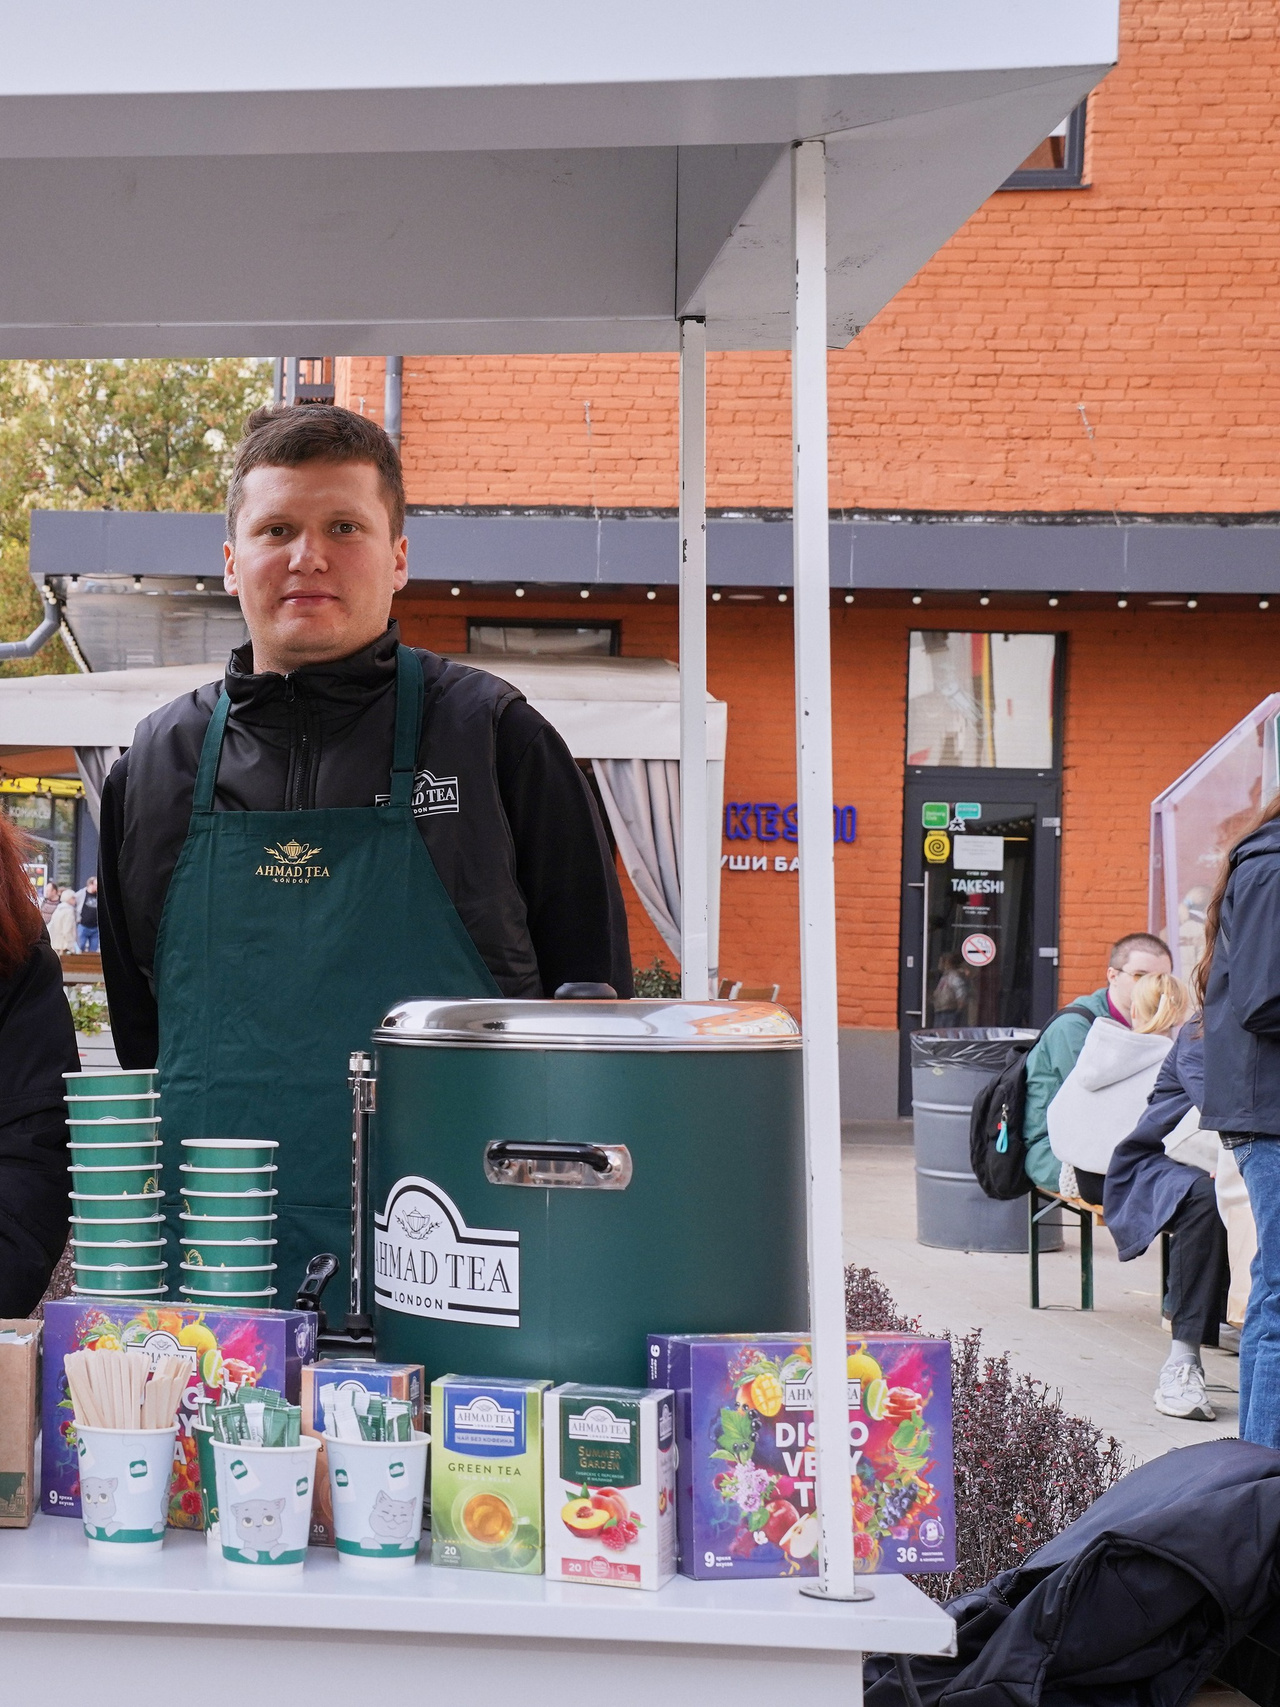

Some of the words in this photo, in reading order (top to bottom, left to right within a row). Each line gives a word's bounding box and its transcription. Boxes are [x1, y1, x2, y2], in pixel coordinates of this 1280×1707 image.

[426, 787, 456, 803] TEA
[726, 802, 856, 842] KESI
[721, 855, 768, 871] УШИ
[774, 856, 800, 872] БА
[255, 866, 302, 878] AHMAD
[305, 866, 330, 878] TEA
[951, 878, 1004, 894] TAKESHI
[445, 1253, 512, 1293] TEA
[394, 1292, 442, 1310] LONDON
[650, 1344, 660, 1358] 9
[457, 1412, 492, 1422] AHMAD
[494, 1414, 512, 1424] TEA
[572, 1423, 608, 1434] AHMAD
[610, 1426, 628, 1435] TEA
[776, 1420, 869, 1448] DISO
[448, 1462, 492, 1474] GREEN
[498, 1466, 522, 1476] TEA
[782, 1451, 863, 1477] VEY
[49, 1490, 58, 1504] 9
[313, 1524, 324, 1533] 20
[444, 1546, 456, 1555] 20
[896, 1546, 918, 1562] 36
[568, 1563, 582, 1572] 20
[704, 1552, 715, 1568] 9
